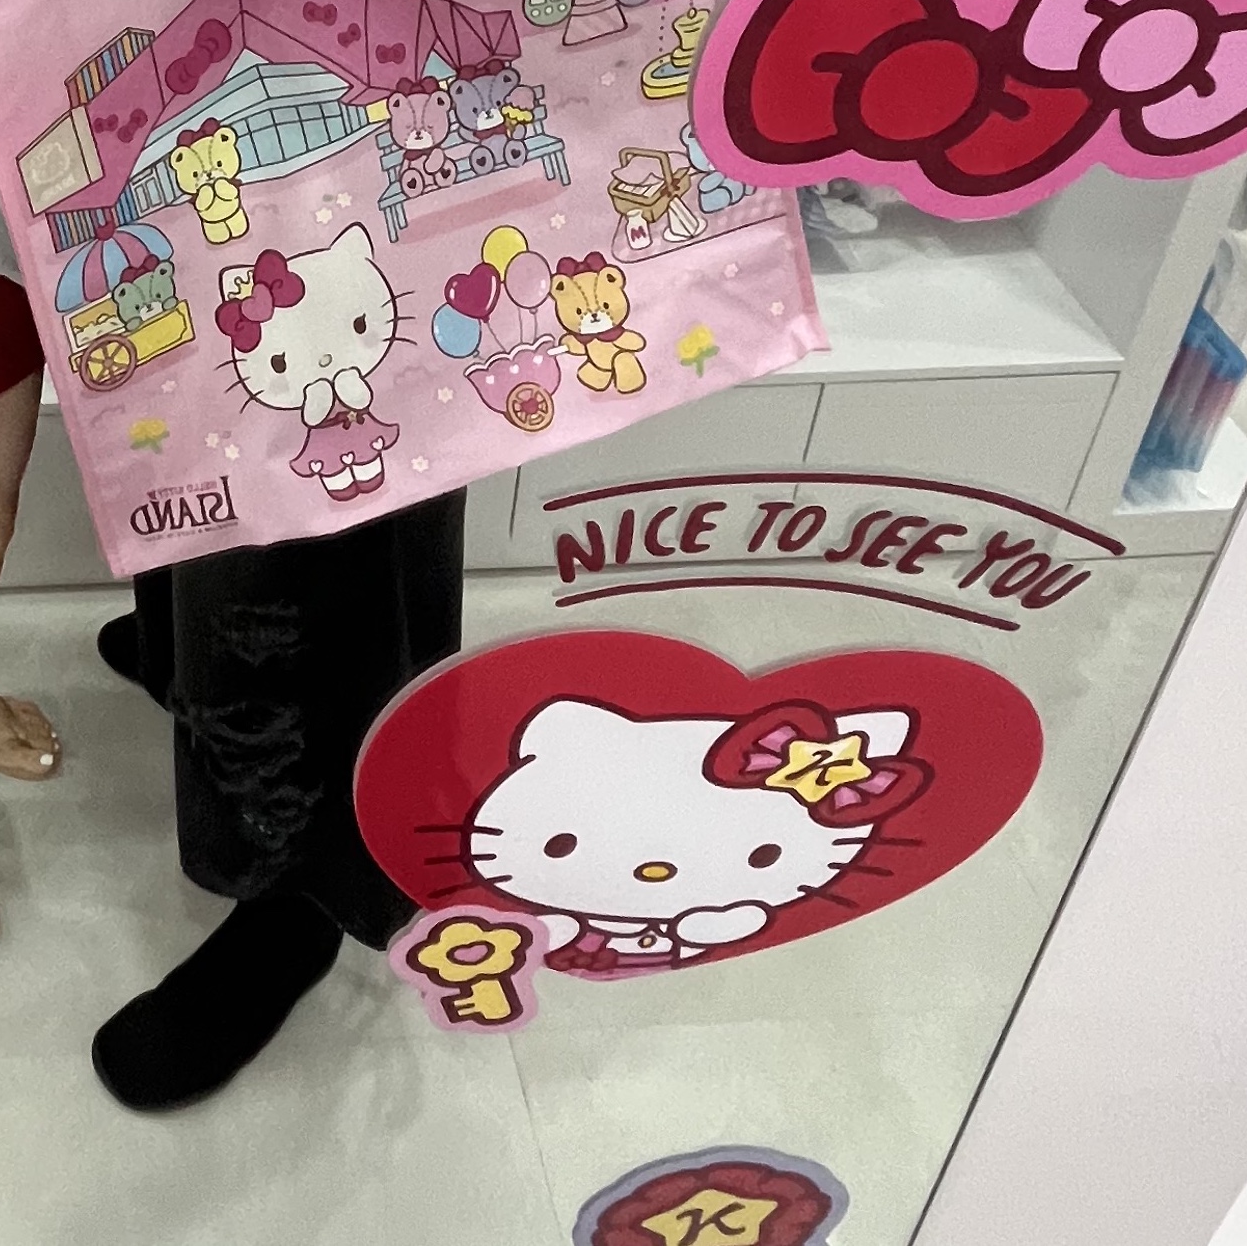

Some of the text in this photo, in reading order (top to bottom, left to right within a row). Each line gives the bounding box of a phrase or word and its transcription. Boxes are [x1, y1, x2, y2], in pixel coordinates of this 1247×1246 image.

[556, 501, 1091, 609] NICE TO SEE YOU
